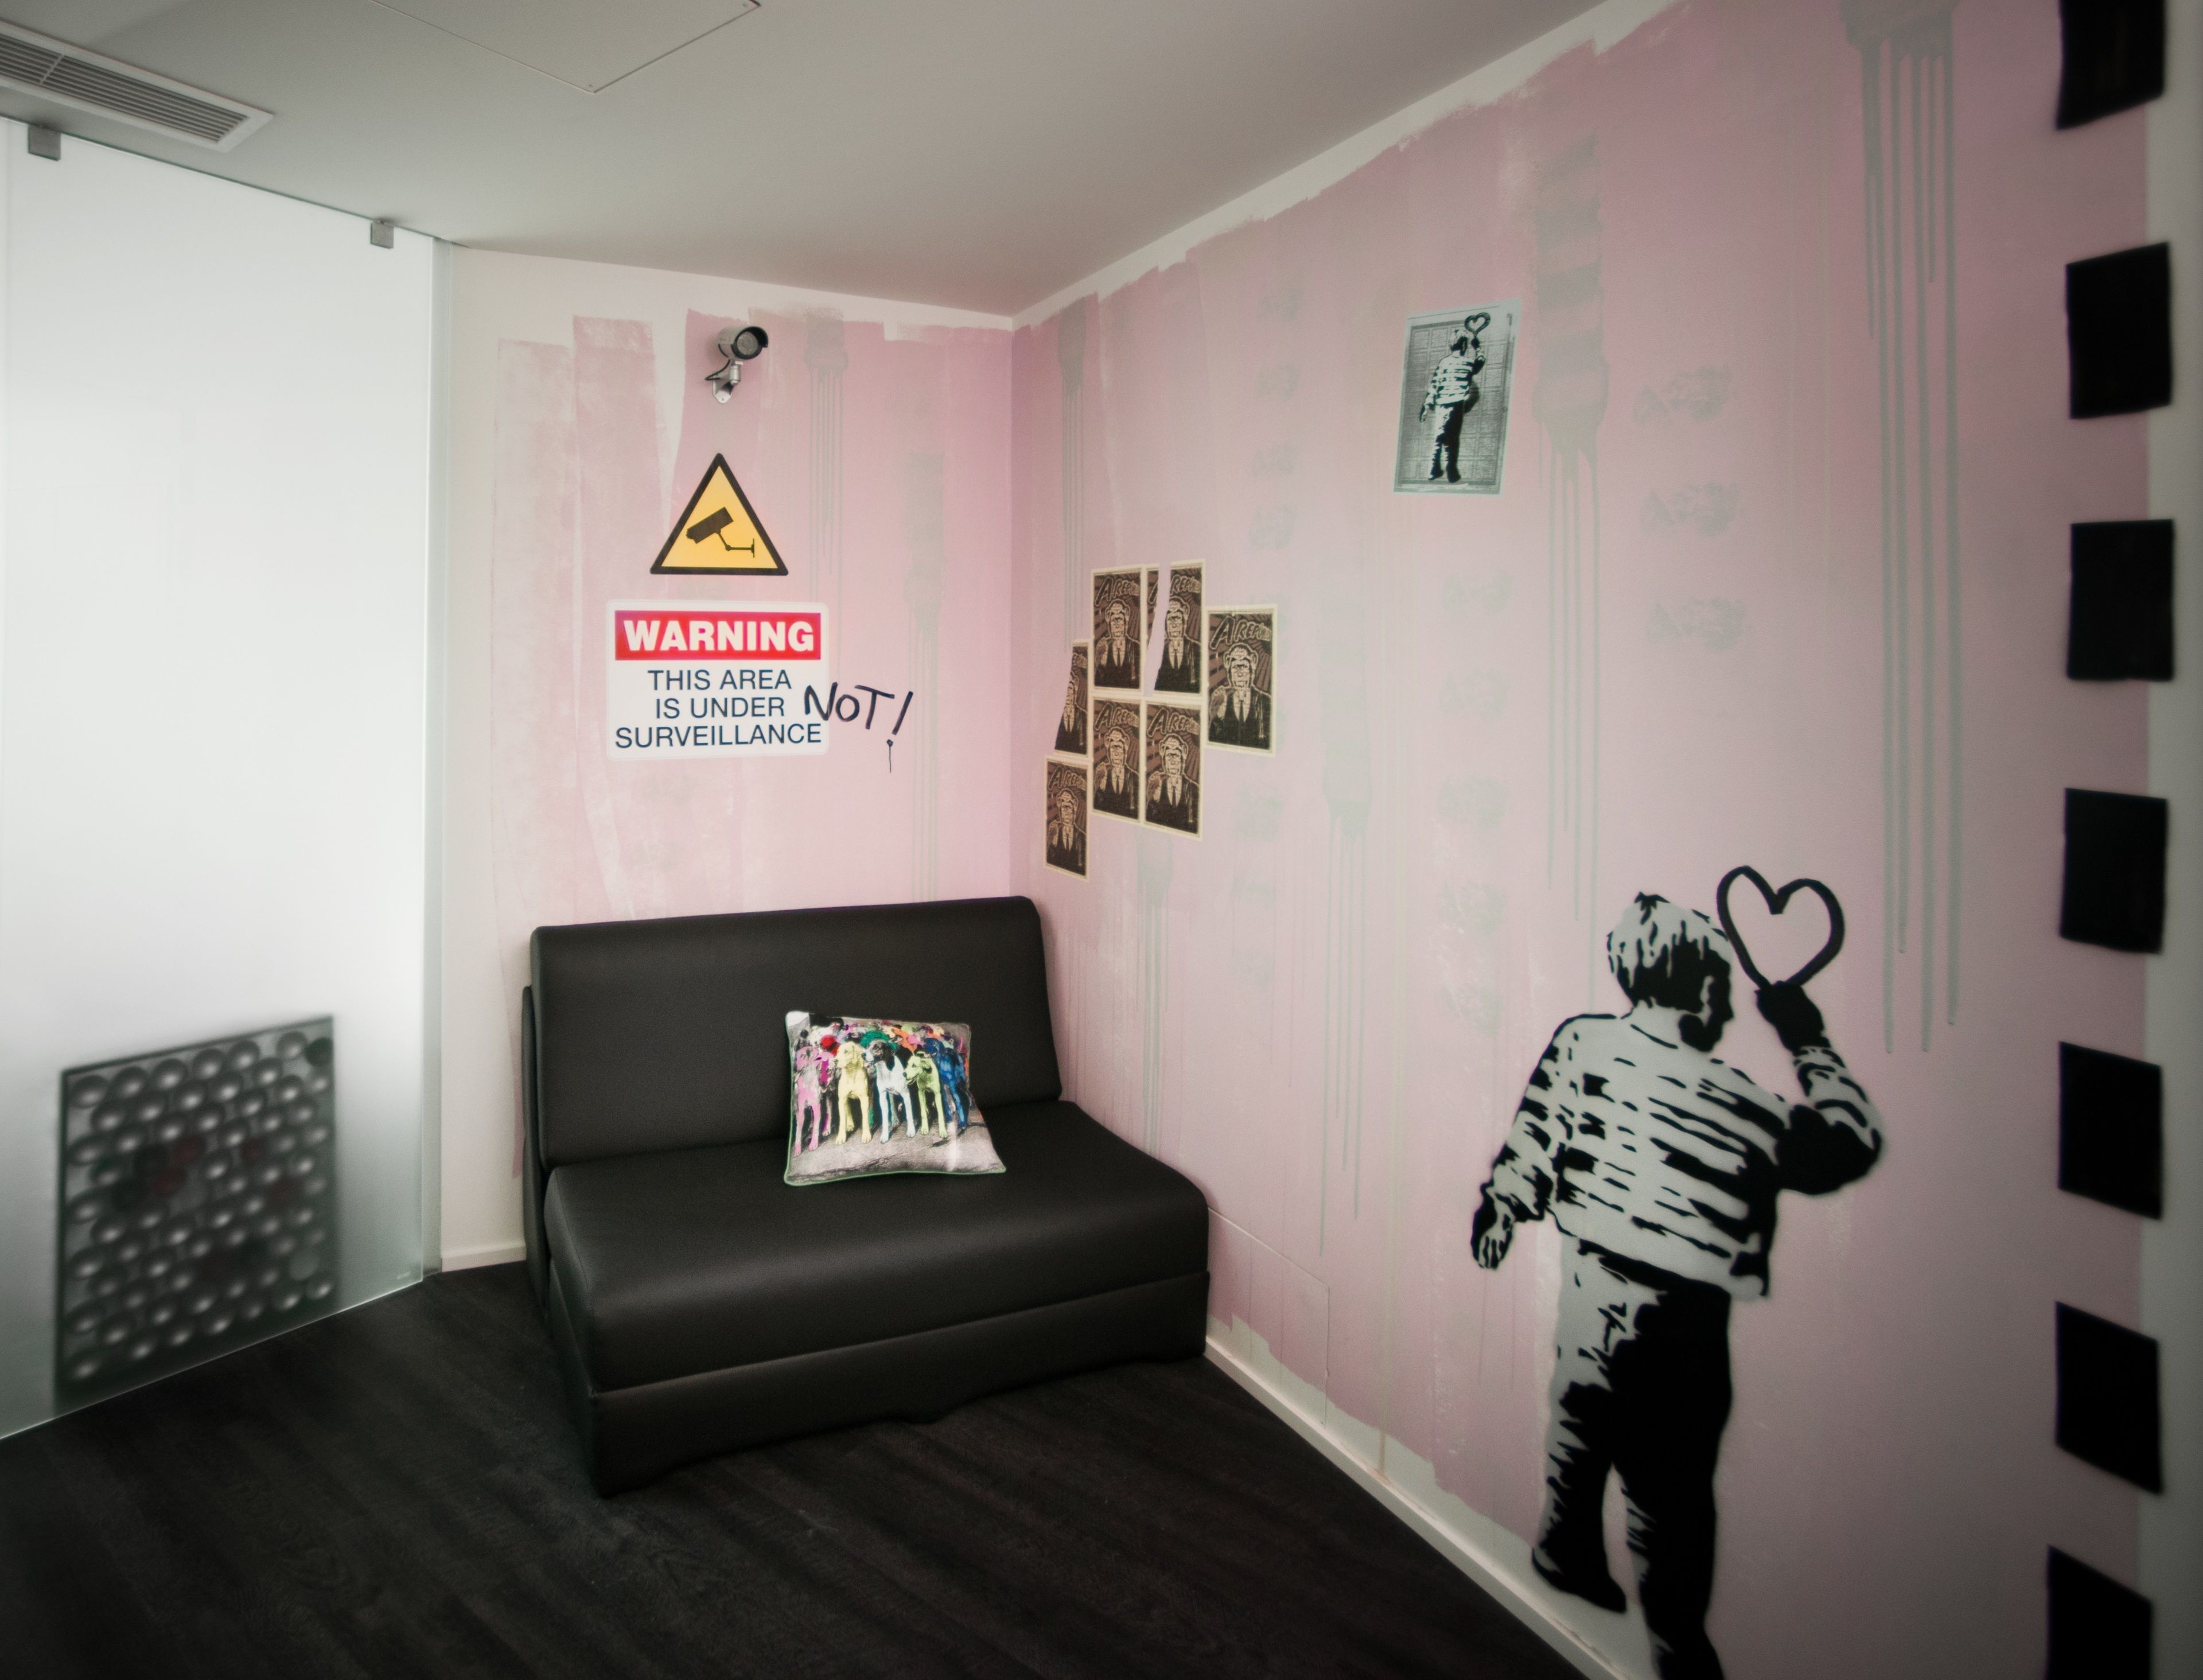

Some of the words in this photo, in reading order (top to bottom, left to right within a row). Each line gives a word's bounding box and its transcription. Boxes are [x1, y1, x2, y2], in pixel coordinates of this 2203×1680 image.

[623, 620, 814, 652] WARNING
[648, 670, 710, 690] THIS
[720, 670, 791, 690] AREA
[656, 698, 679, 719] IS
[691, 697, 784, 718] UNDER
[804, 682, 913, 746] NOT!
[616, 724, 821, 748] SURVEILLANCE
